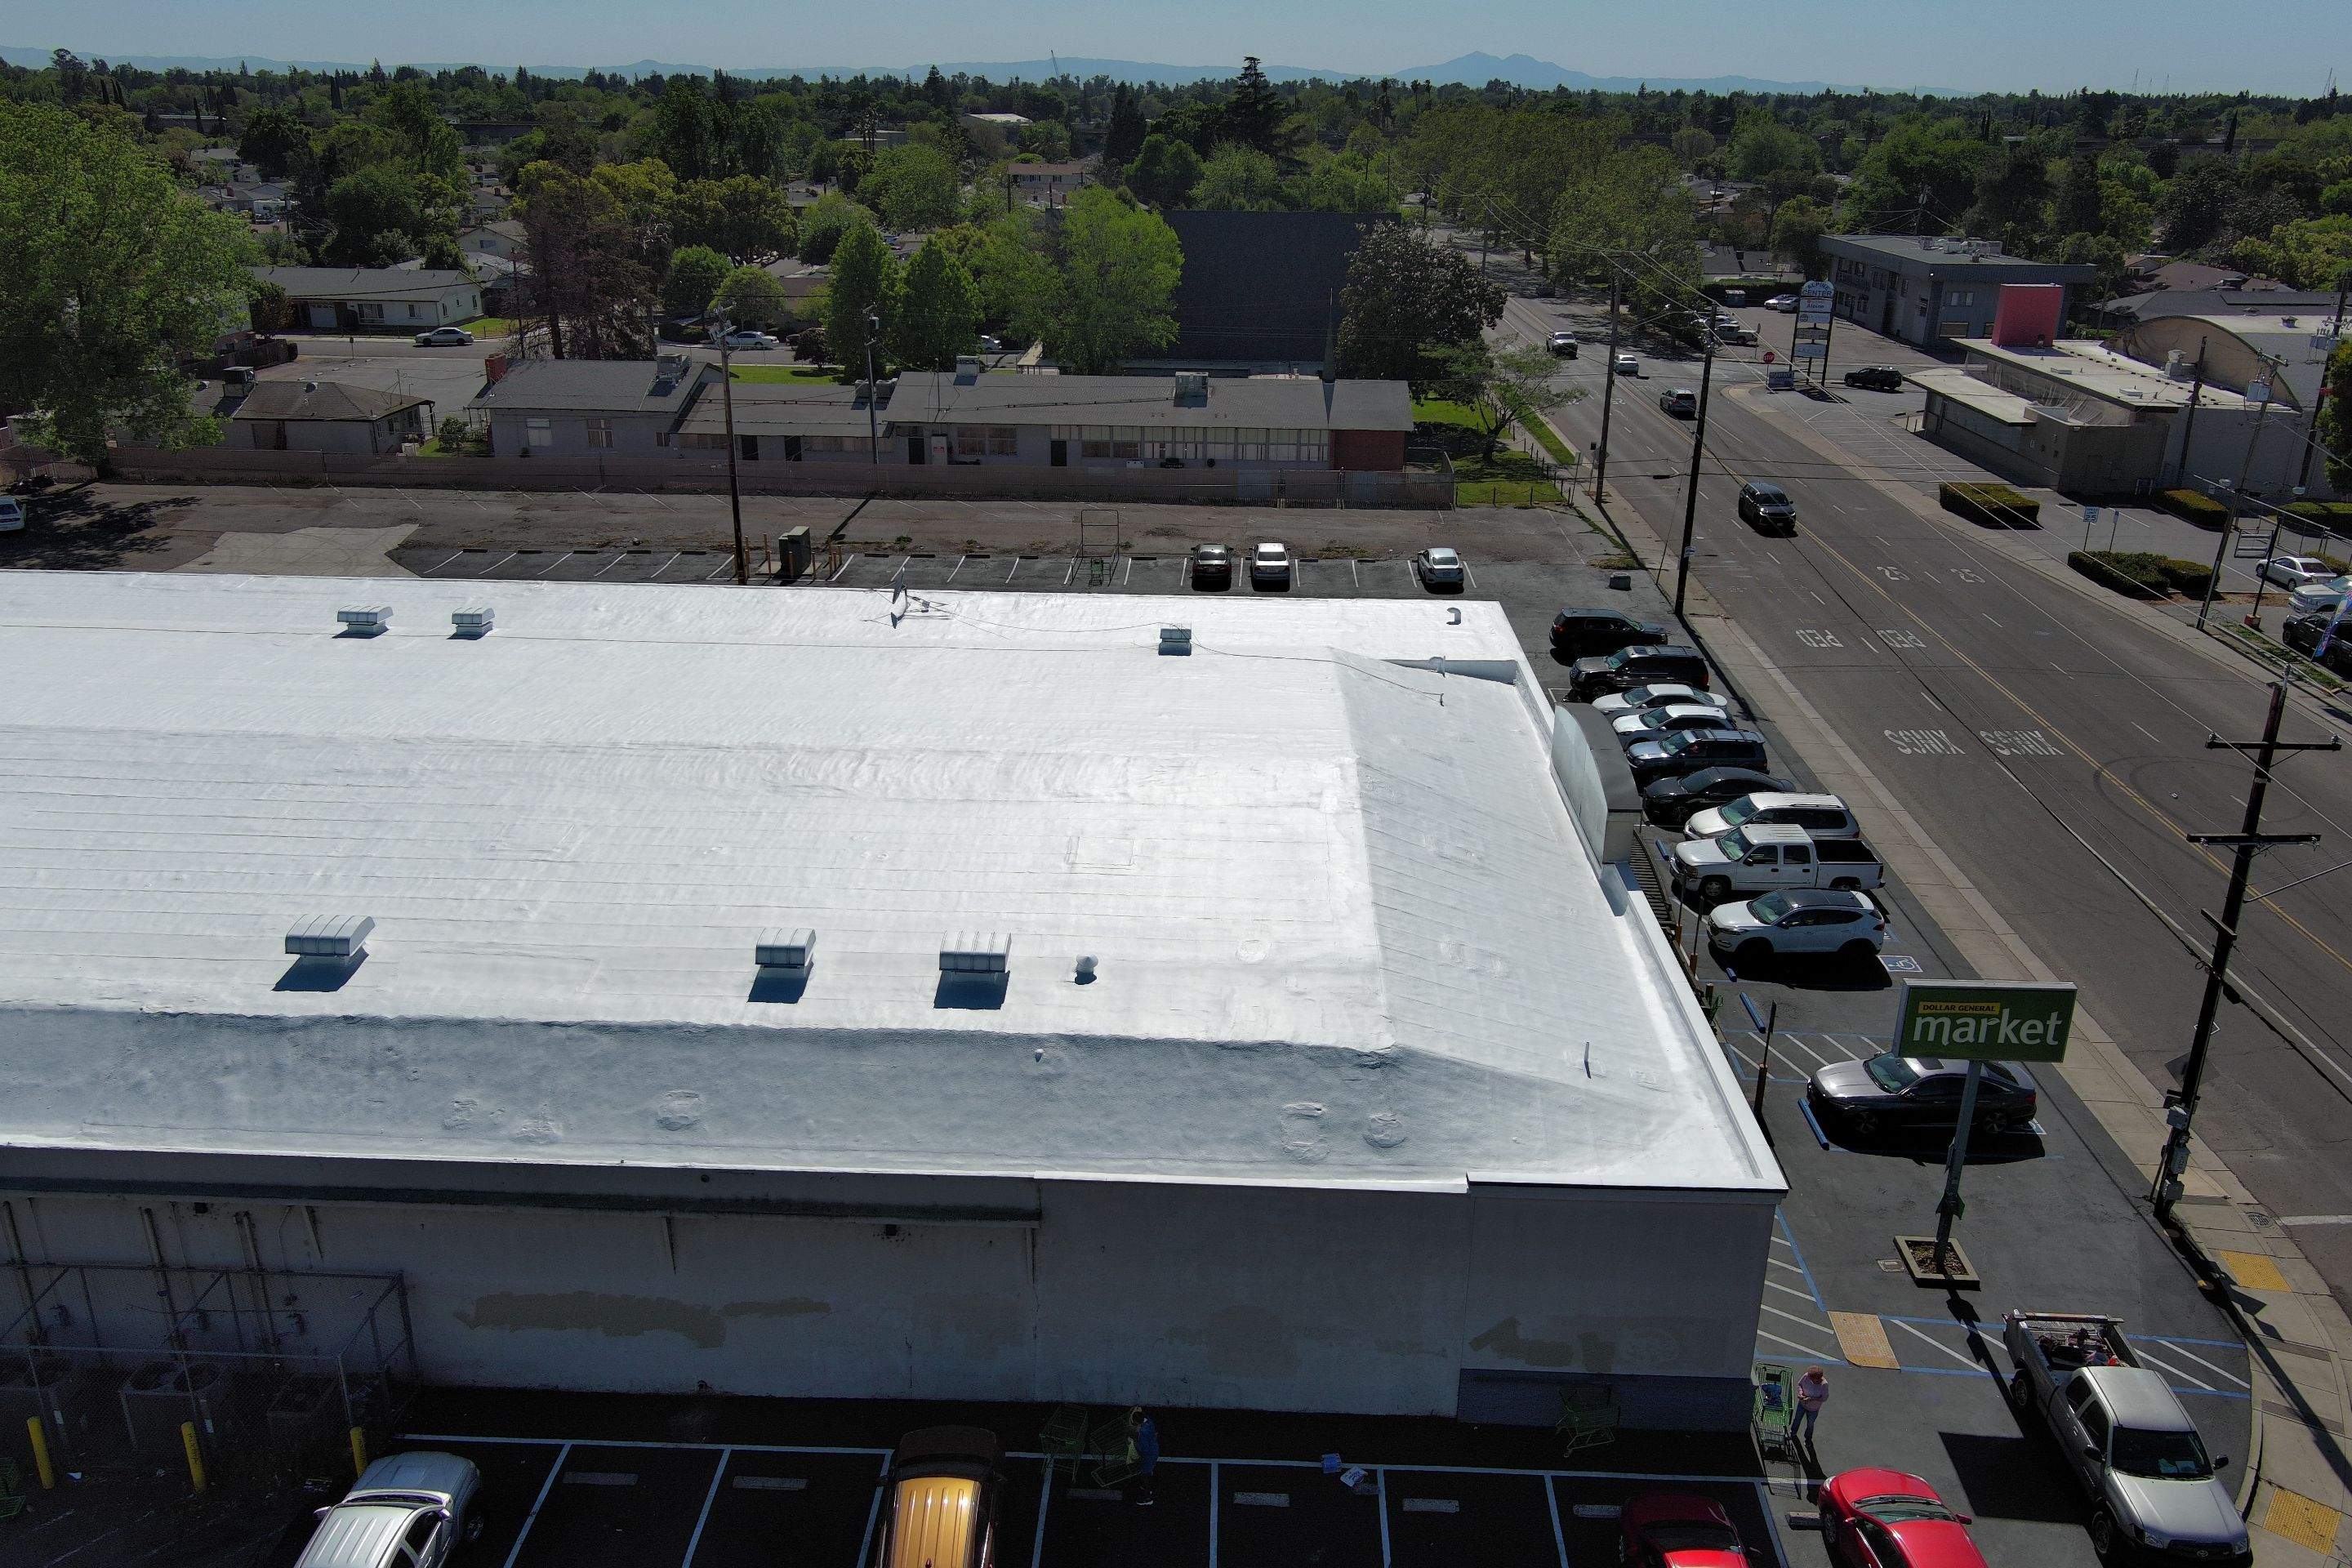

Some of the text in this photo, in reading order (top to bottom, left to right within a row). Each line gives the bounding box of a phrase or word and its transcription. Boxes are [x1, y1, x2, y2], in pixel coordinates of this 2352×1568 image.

[1802, 289, 1832, 297] CENTER
[1807, 282, 1830, 292] ALPINE
[1796, 630, 1844, 648] PED
[1877, 630, 1927, 648] PED
[1913, 1008, 2062, 1046] market
